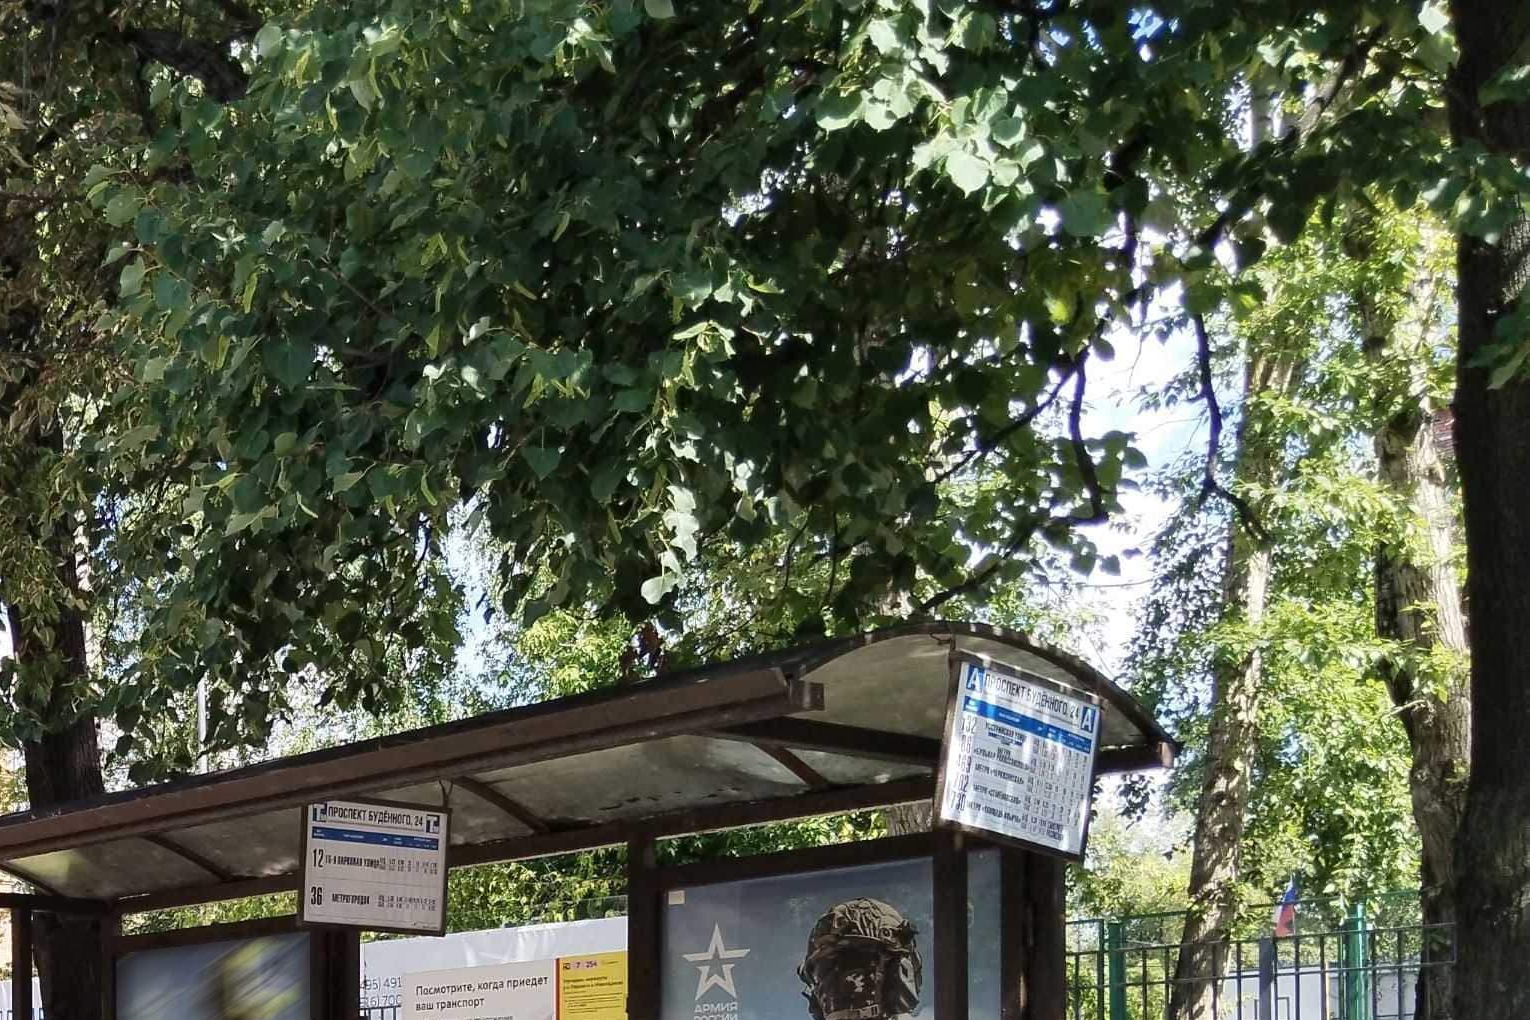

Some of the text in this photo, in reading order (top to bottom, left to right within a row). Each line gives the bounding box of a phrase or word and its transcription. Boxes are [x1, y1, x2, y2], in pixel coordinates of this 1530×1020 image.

[985, 673, 1025, 698] ПРОСПЕКТ
[328, 806, 367, 820] ПРОСПЕКТ
[414, 815, 423, 827] 24
[313, 849, 324, 868] 12
[311, 887, 323, 905] 36
[415, 982, 475, 996] Посмотрите,
[478, 980, 504, 991] когда
[507, 976, 548, 989] приедет
[416, 998, 485, 1011] ваш транспорт
[694, 1001, 738, 1014] АРМИЯ
